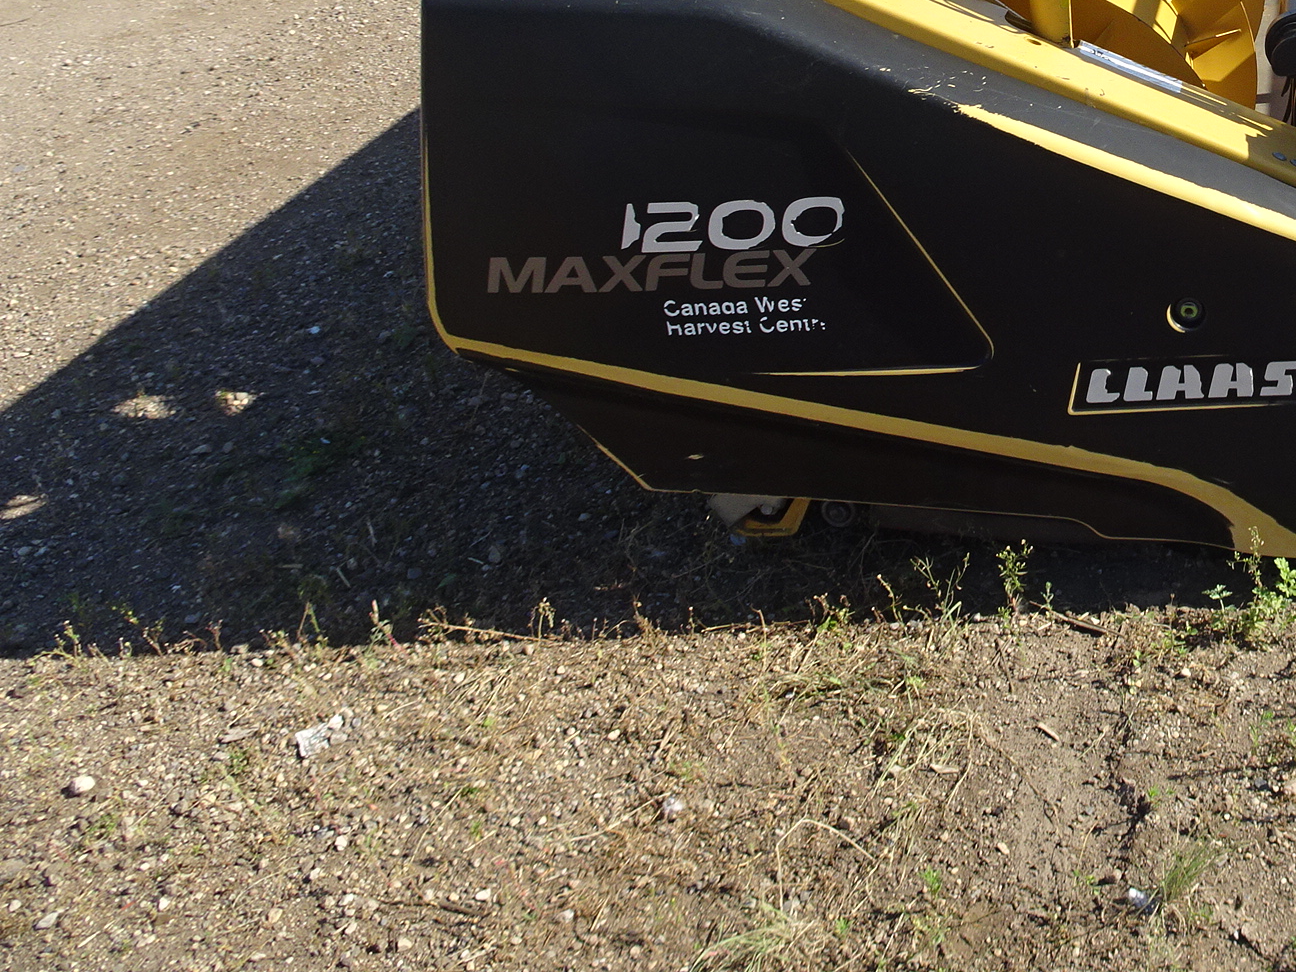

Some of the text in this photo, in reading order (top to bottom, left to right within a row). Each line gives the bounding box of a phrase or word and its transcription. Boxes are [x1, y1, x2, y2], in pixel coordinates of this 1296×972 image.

[620, 196, 845, 253] 1200
[487, 248, 817, 294] MAXFLEX
[663, 296, 807, 317] Canada Wes
[666, 320, 752, 336] Harvest
